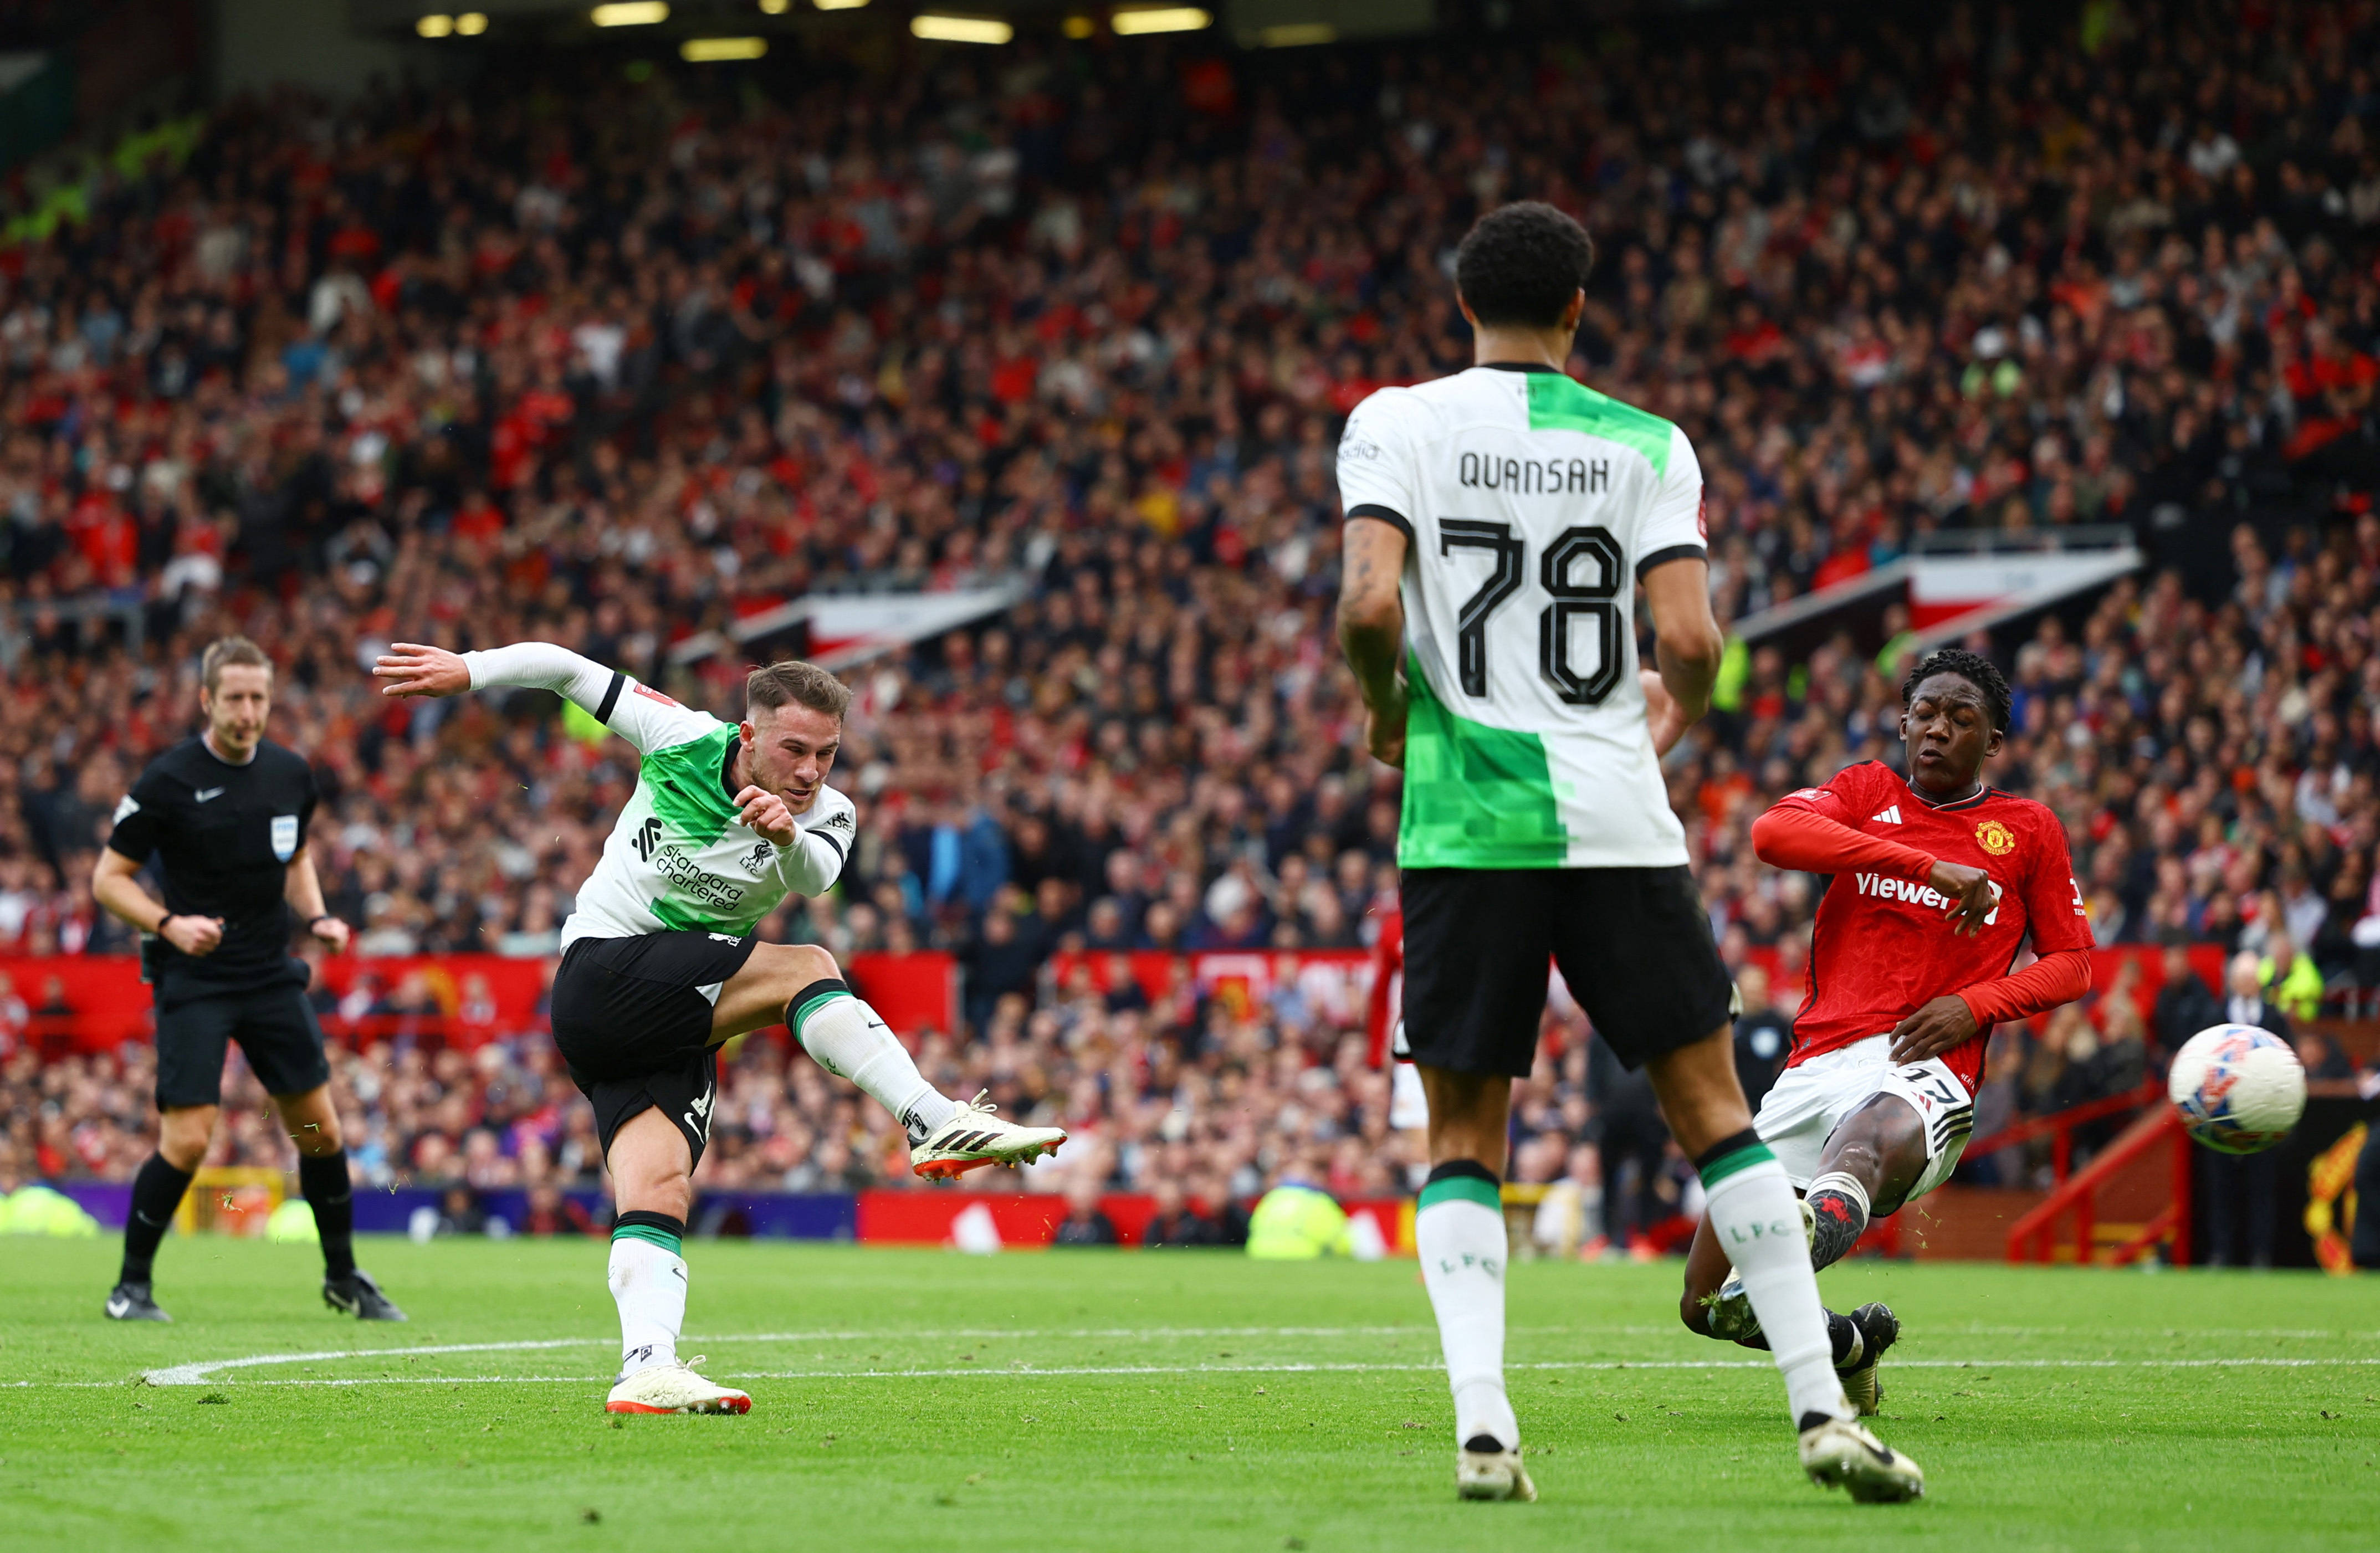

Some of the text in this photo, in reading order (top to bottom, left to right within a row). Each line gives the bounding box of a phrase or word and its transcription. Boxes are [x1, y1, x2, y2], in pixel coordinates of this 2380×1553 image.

[1461, 452, 1609, 494] QUANSAH
[1439, 517, 1623, 705] 78
[657, 858, 739, 911] chartered
[664, 845, 744, 901] standard
[1730, 1220, 1791, 1244] LFC
[1440, 1253, 1498, 1278] LFC
